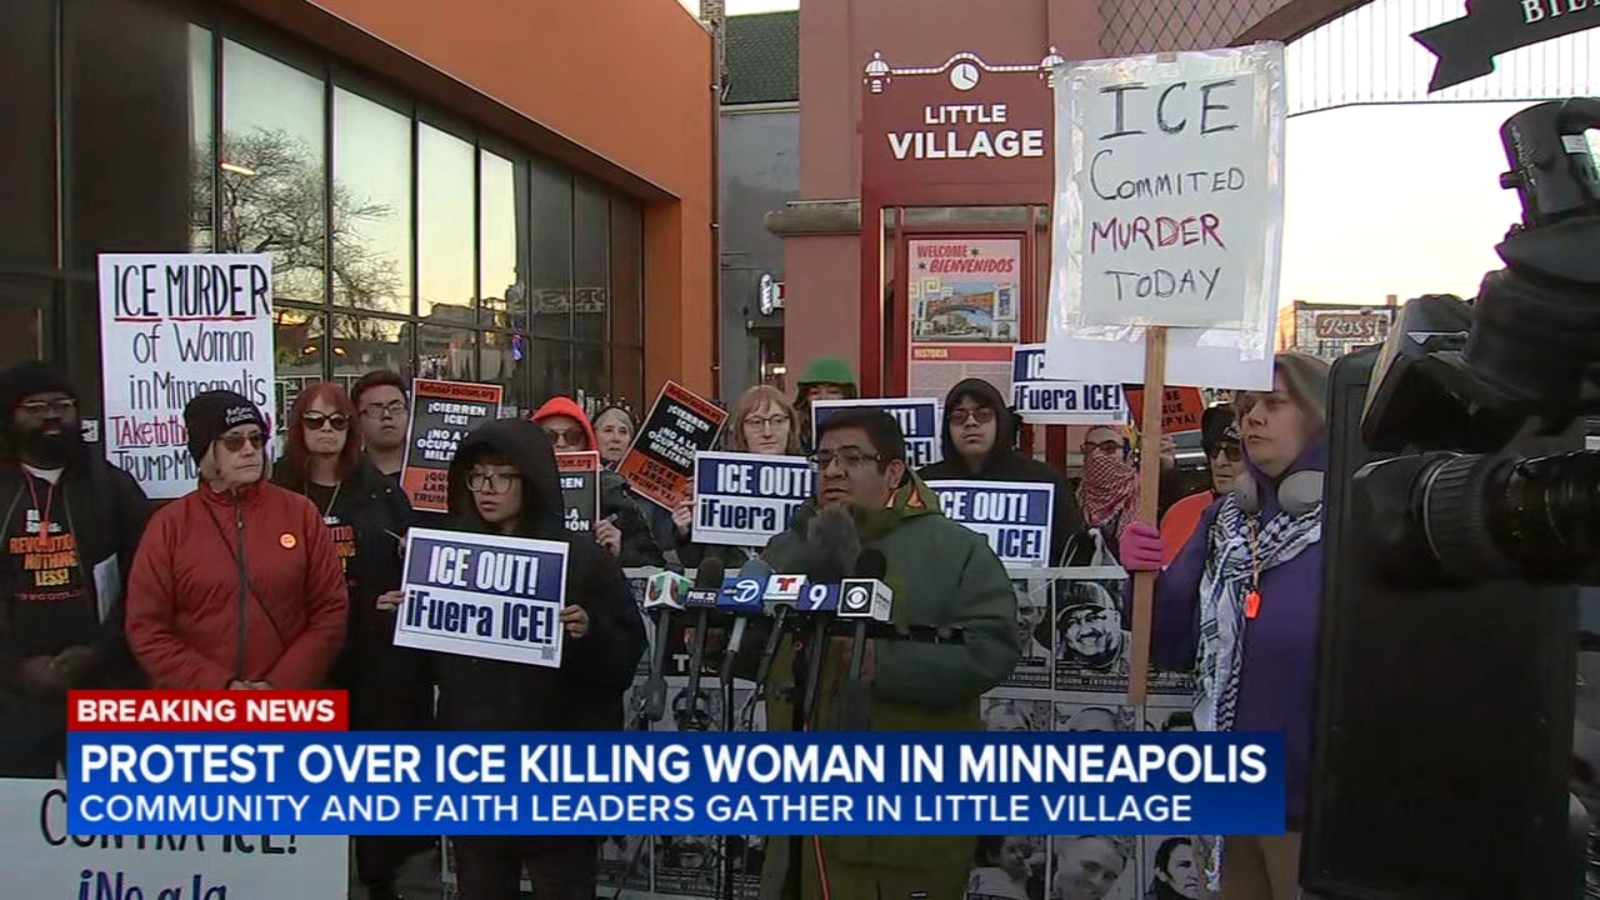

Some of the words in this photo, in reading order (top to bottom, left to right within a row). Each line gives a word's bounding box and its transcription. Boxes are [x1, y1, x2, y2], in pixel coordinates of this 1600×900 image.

[924, 104, 1007, 125] LITTLE
[1098, 79, 1240, 140] ICE
[887, 129, 1044, 160] VILLAGE
[1090, 212, 1226, 254] MURDER
[917, 245, 968, 258] WELCOME
[929, 258, 1014, 273] BIENVENIDOS
[114, 264, 158, 317] ICE
[165, 263, 271, 317] MURDER
[133, 324, 160, 364] of
[174, 324, 254, 363] Woman
[1027, 353, 1045, 379] IC
[1014, 385, 1077, 410] ¡Fuera
[1083, 384, 1120, 410] ICE!
[444, 414, 468, 426] ICE!
[452, 431, 461, 441] A
[647, 429, 698, 461] OCUPACIÓ
[425, 472, 446, 482] ¡QU
[717, 463, 753, 494] ICE
[759, 466, 812, 497] OUT!
[700, 498, 776, 531] ¡Fuera
[935, 491, 967, 520] CE
[973, 492, 1028, 522] OUT!
[997, 528, 1041, 558] ICE!
[35, 568, 70, 586] LESS!
[428, 545, 471, 587] ICE
[475, 551, 539, 596] OUT!
[809, 584, 827, 610] 9
[405, 589, 494, 637] ¡Fuera
[501, 602, 554, 645] ICE!
